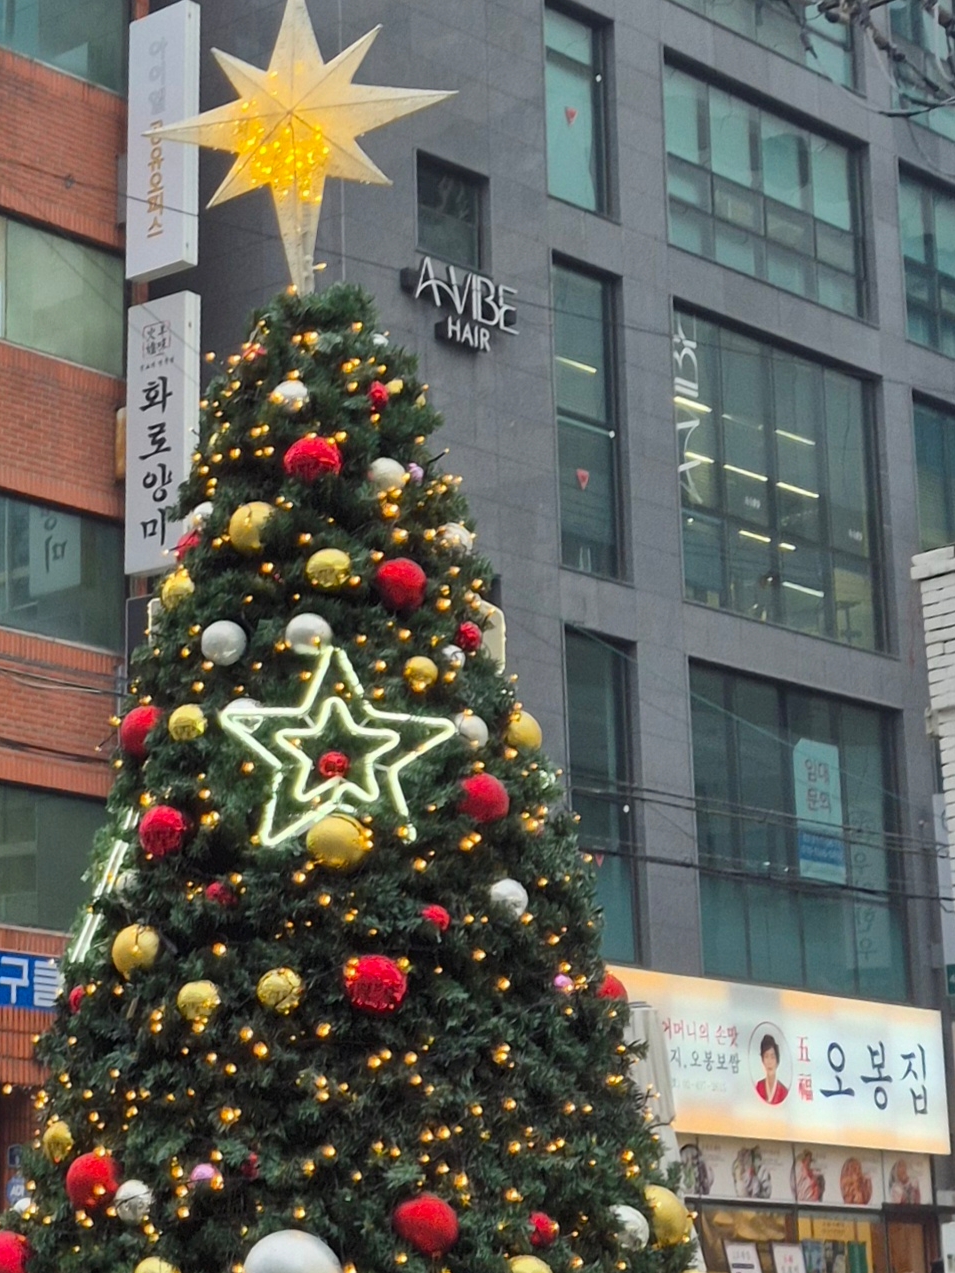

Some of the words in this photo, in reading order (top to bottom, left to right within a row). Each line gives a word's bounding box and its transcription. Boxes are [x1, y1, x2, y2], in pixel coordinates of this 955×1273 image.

[415, 256, 520, 335] AVIBE
[448, 315, 491, 352] HAIR
[139, 376, 173, 546] 화로양미
[715, 1025, 738, 1048] 손맛
[820, 1041, 928, 1115] 오봉집
